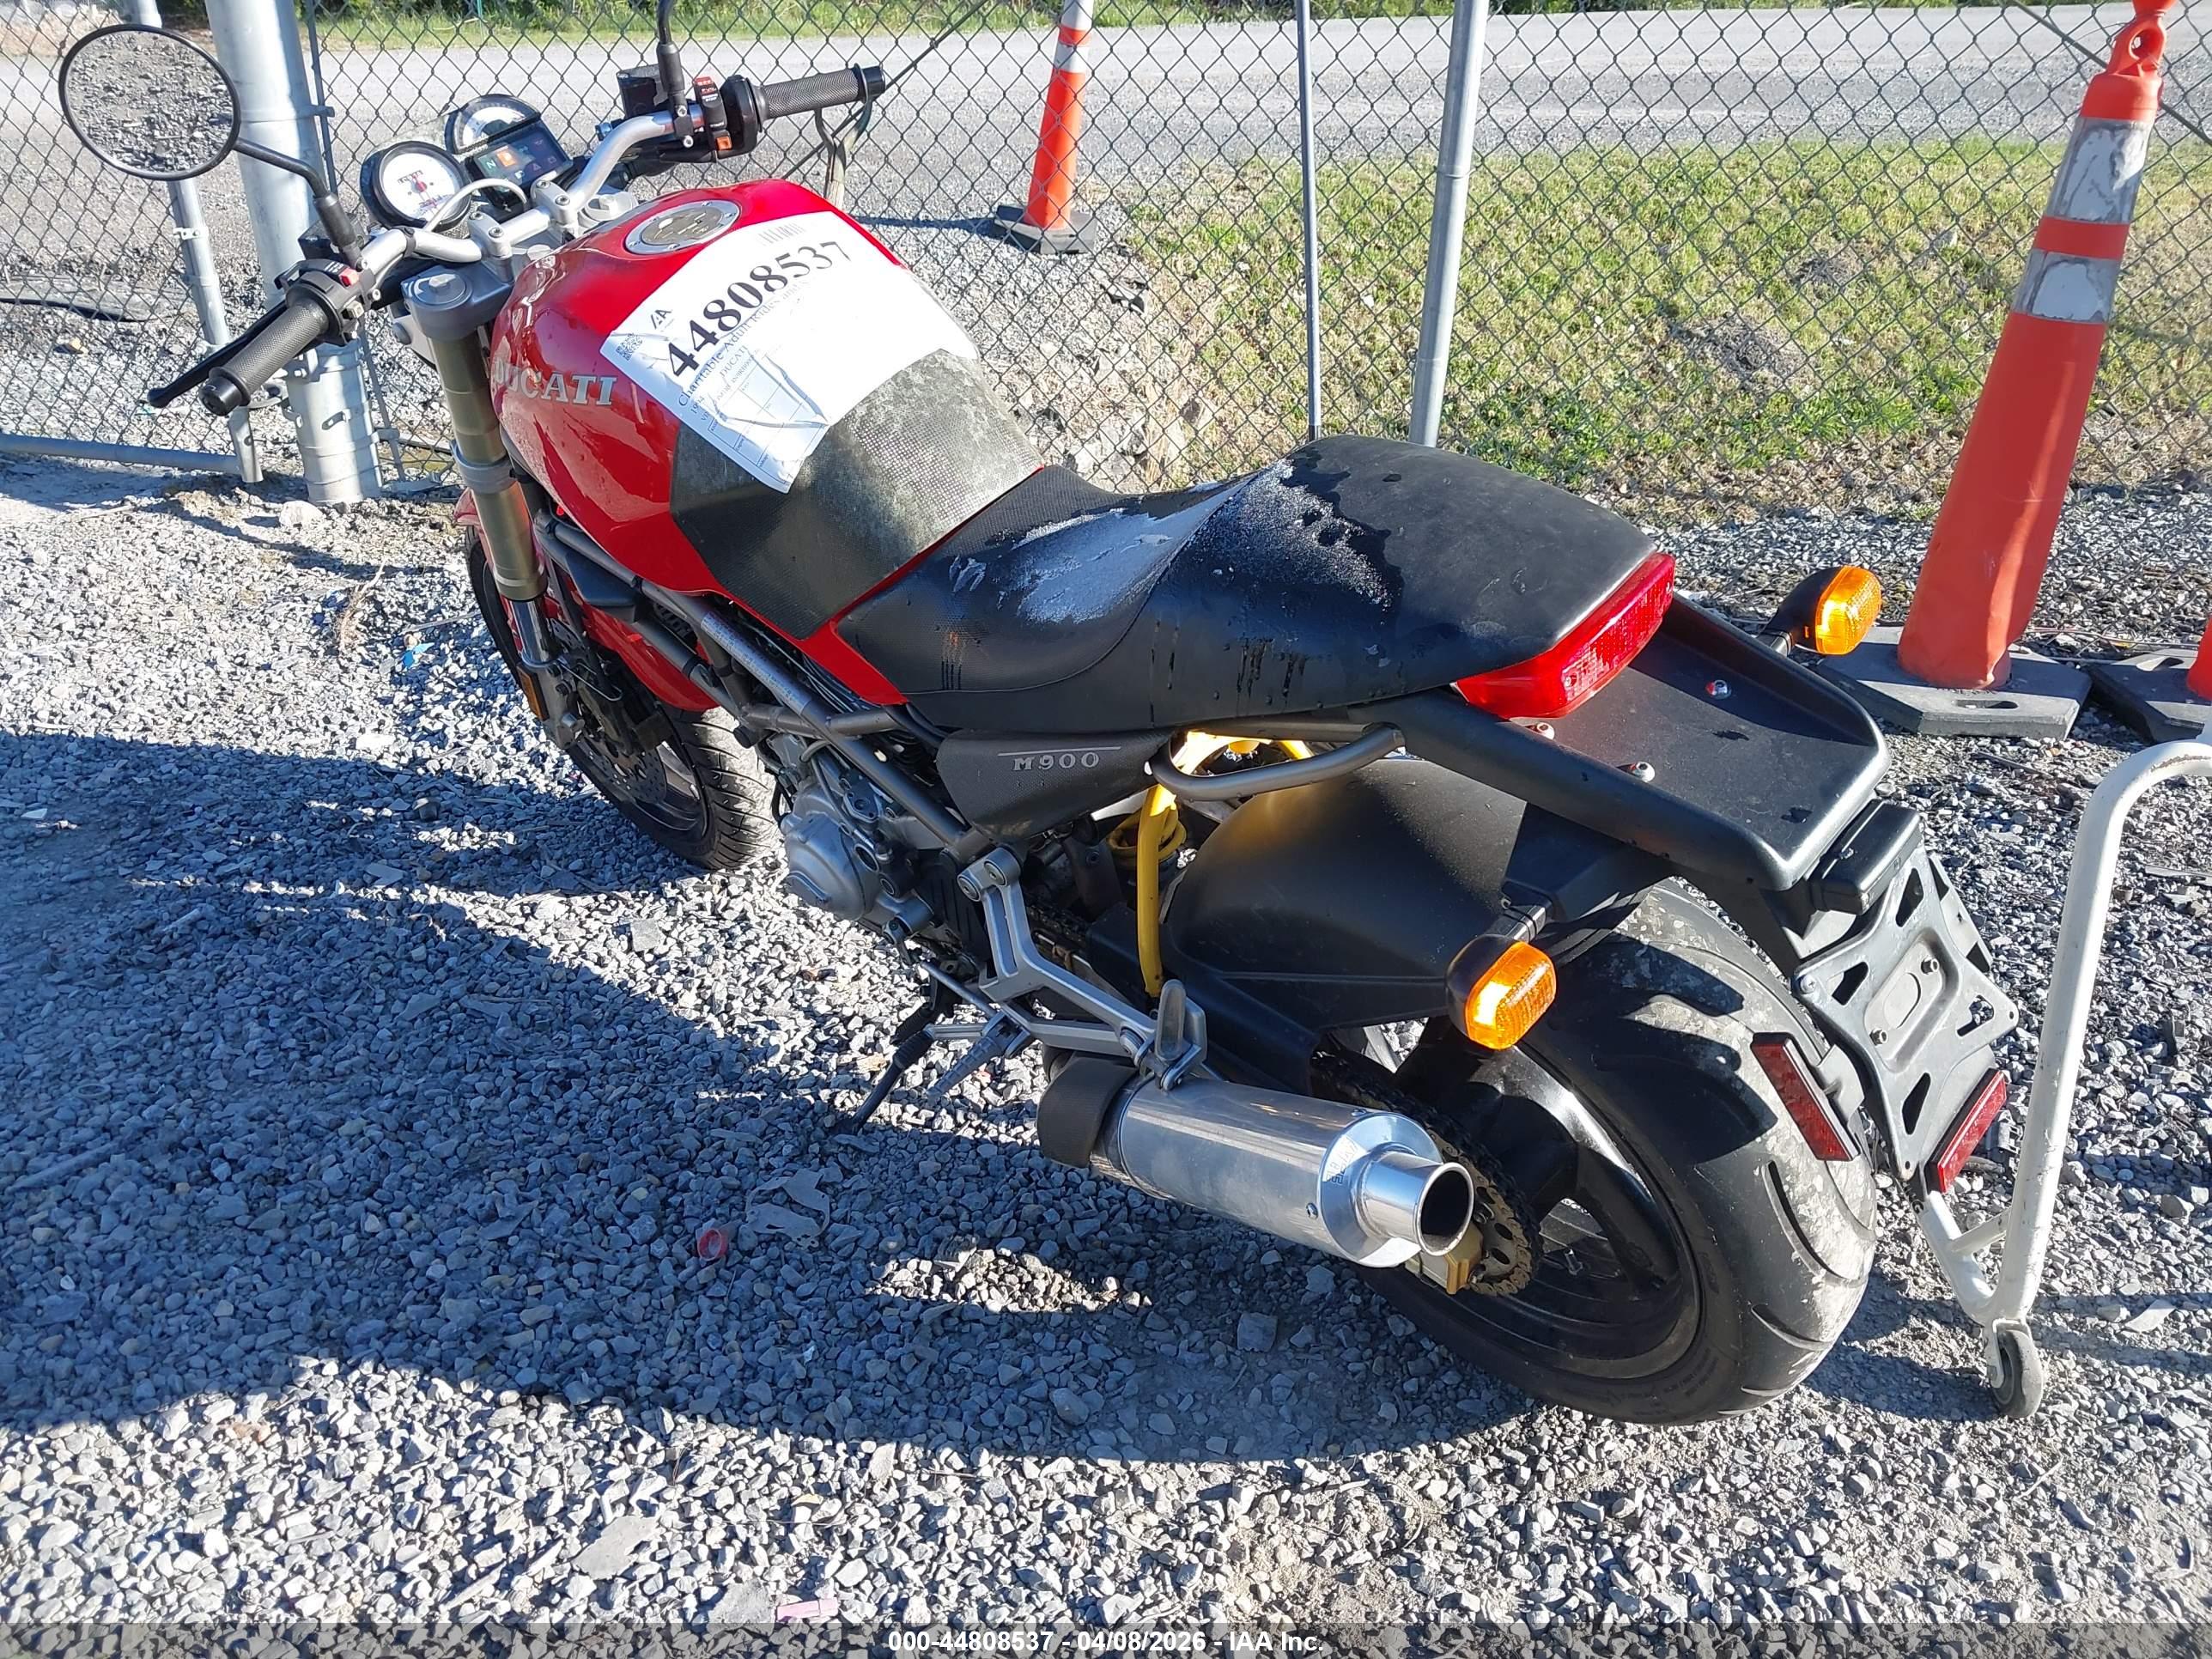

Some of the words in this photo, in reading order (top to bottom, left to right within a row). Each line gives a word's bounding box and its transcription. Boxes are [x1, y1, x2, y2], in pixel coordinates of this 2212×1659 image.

[668, 241, 851, 377] 44808537
[495, 357, 617, 406] DUCATI
[678, 351, 724, 406] Charitable
[724, 321, 750, 352] Adult
[720, 345, 748, 378] DUCATI
[1013, 752, 1099, 771] M900
